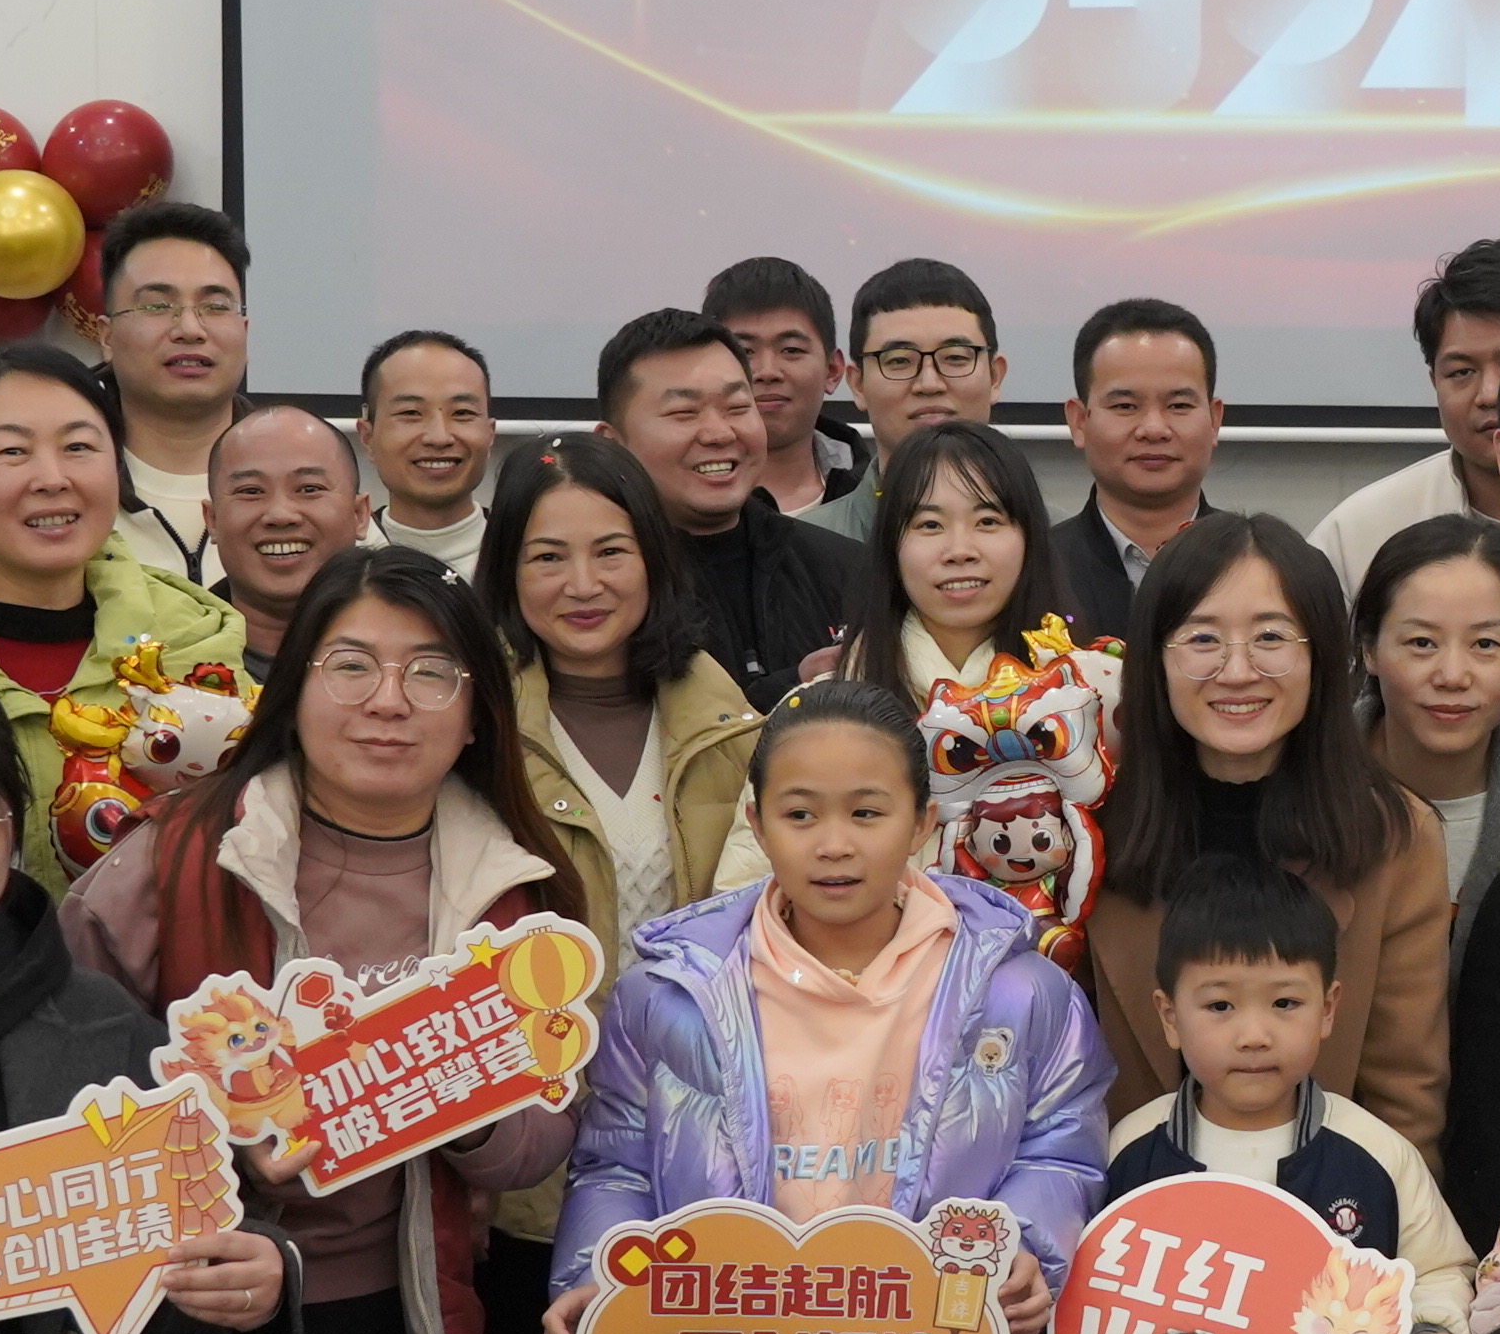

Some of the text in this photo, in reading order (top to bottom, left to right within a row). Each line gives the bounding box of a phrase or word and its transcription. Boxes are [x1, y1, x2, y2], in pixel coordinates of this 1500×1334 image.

[303, 983, 519, 1115] 初心致远
[320, 1027, 538, 1160] 破岩攀登
[649, 1262, 914, 1320] 团结起航
[1088, 1217, 1266, 1330] 红红
